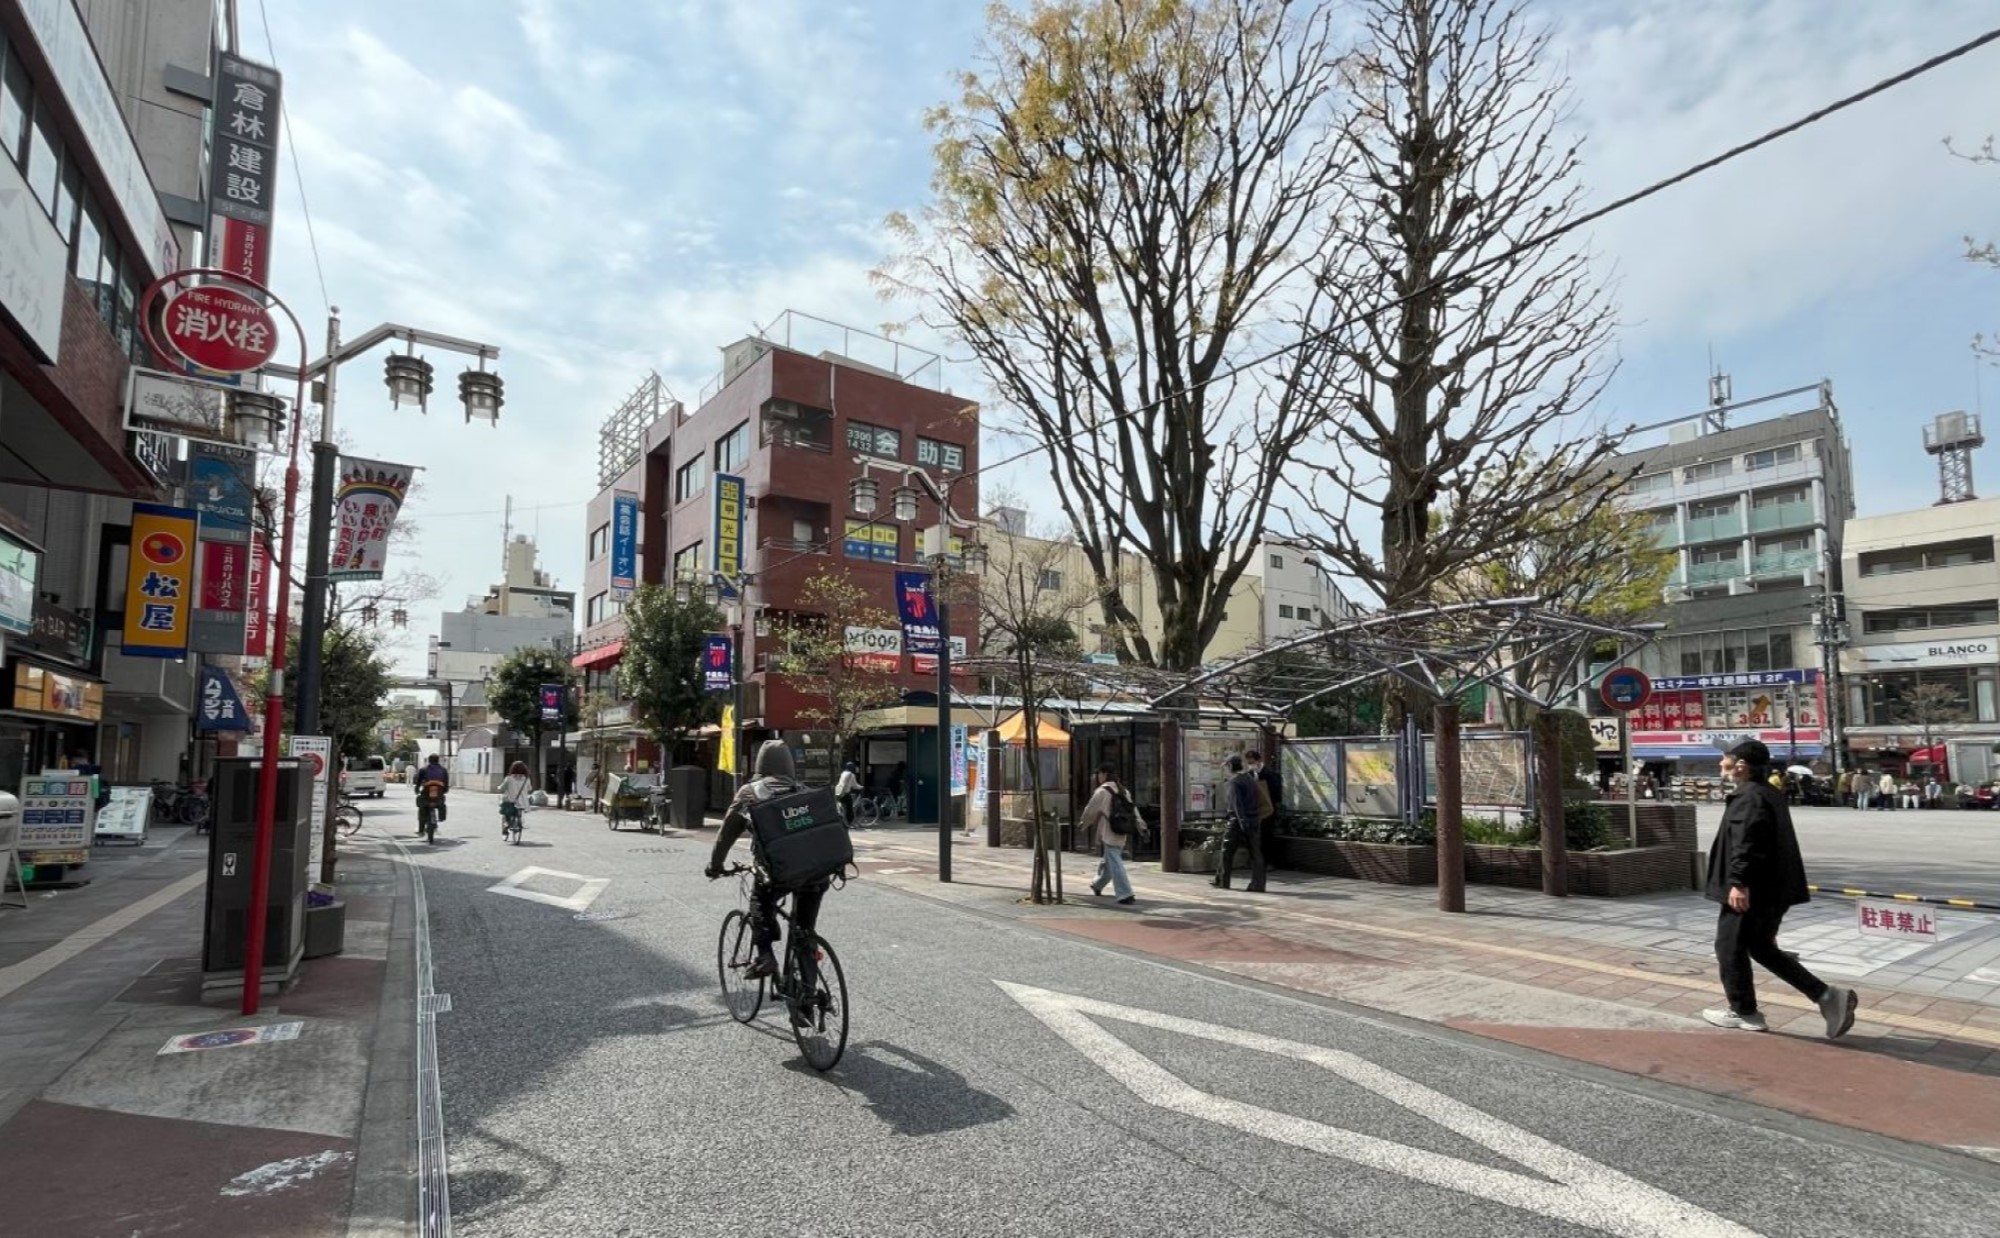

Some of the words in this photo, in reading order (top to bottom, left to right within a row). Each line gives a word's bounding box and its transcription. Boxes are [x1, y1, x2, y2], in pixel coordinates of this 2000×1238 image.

[227, 82, 268, 205] 倉林建設
[188, 292, 210, 305] FIRE
[214, 296, 262, 316] HYDRANT
[175, 304, 270, 354] 消火栓
[847, 439, 871, 452] 1432
[848, 429, 872, 442] 3300
[876, 432, 899, 457] 会
[220, 546, 234, 608] 三井のリハウス
[139, 571, 181, 632] 松屋
[1928, 644, 1988, 657] BLANCO
[1651, 680, 1697, 690] セミナー
[781, 805, 809, 819] Uber
[784, 816, 814, 830] Eats
[1862, 906, 1936, 936] 駐車禁止
